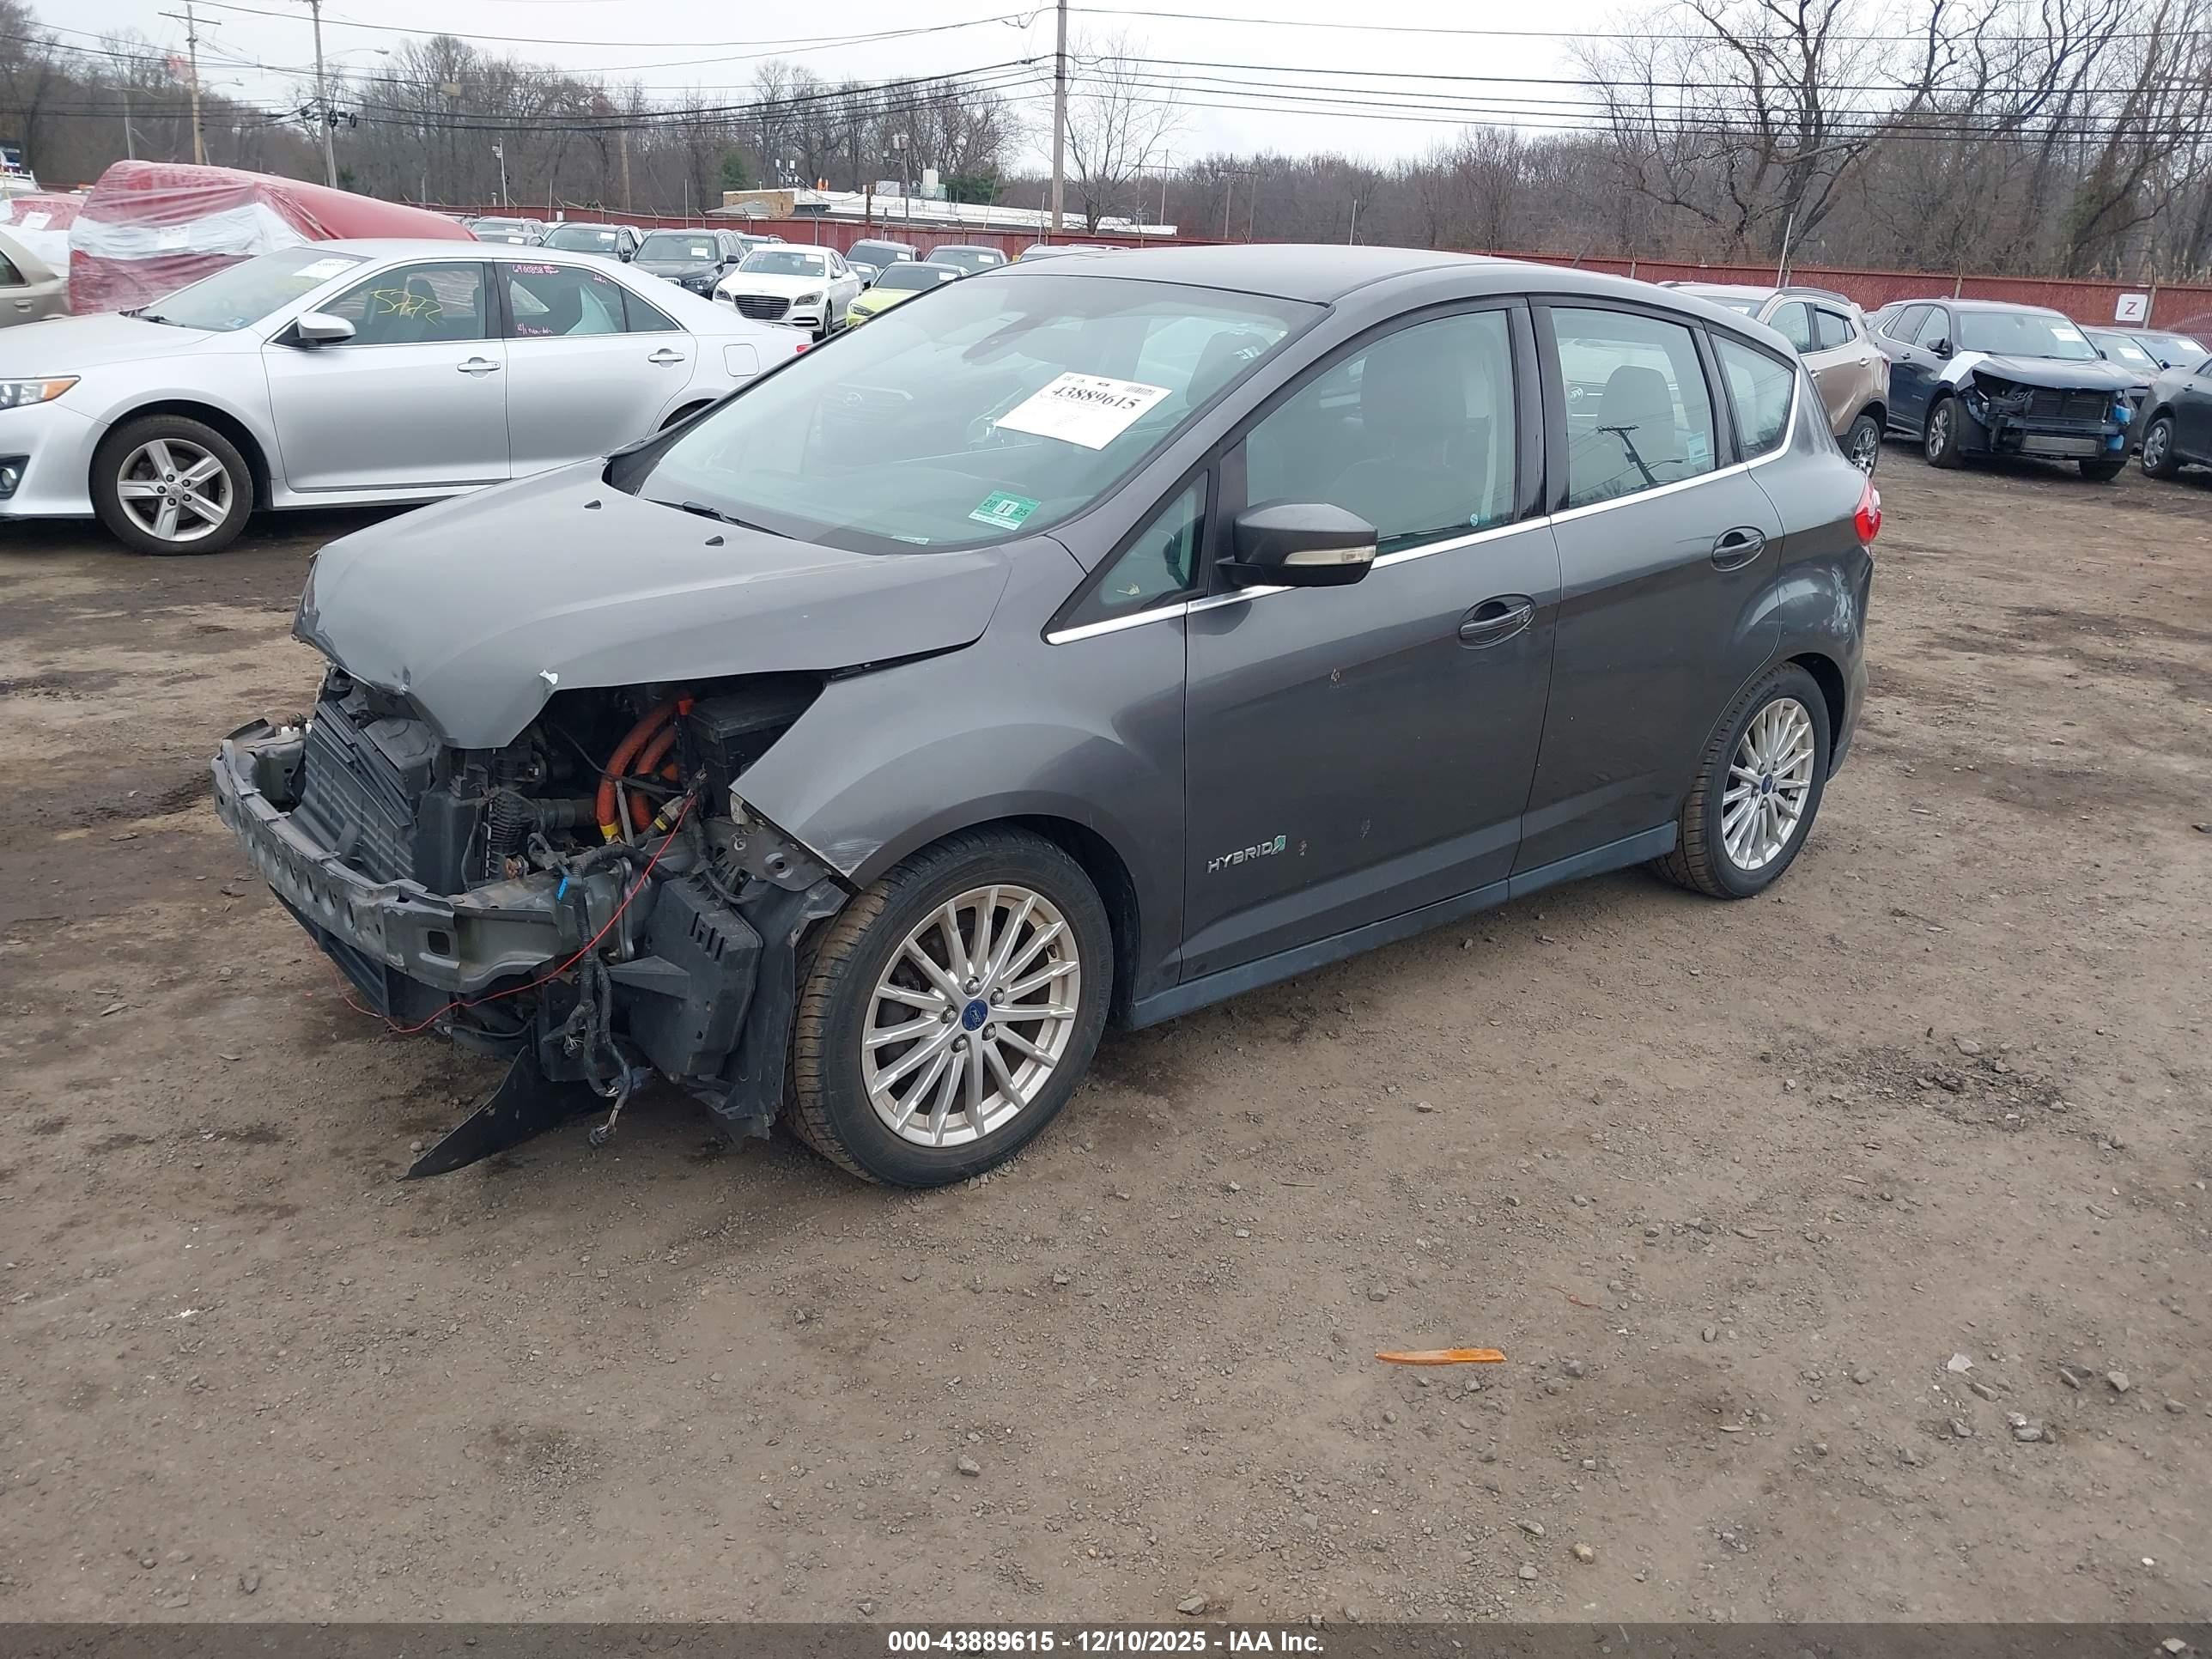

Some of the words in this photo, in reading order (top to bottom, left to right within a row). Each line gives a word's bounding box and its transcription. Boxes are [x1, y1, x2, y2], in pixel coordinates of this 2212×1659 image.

[2124, 301, 2138, 315] Z
[1052, 386, 1141, 410] 43889615
[983, 499, 998, 508] 20
[1014, 507, 1030, 517] 25
[1206, 842, 1273, 873] HYBRID
